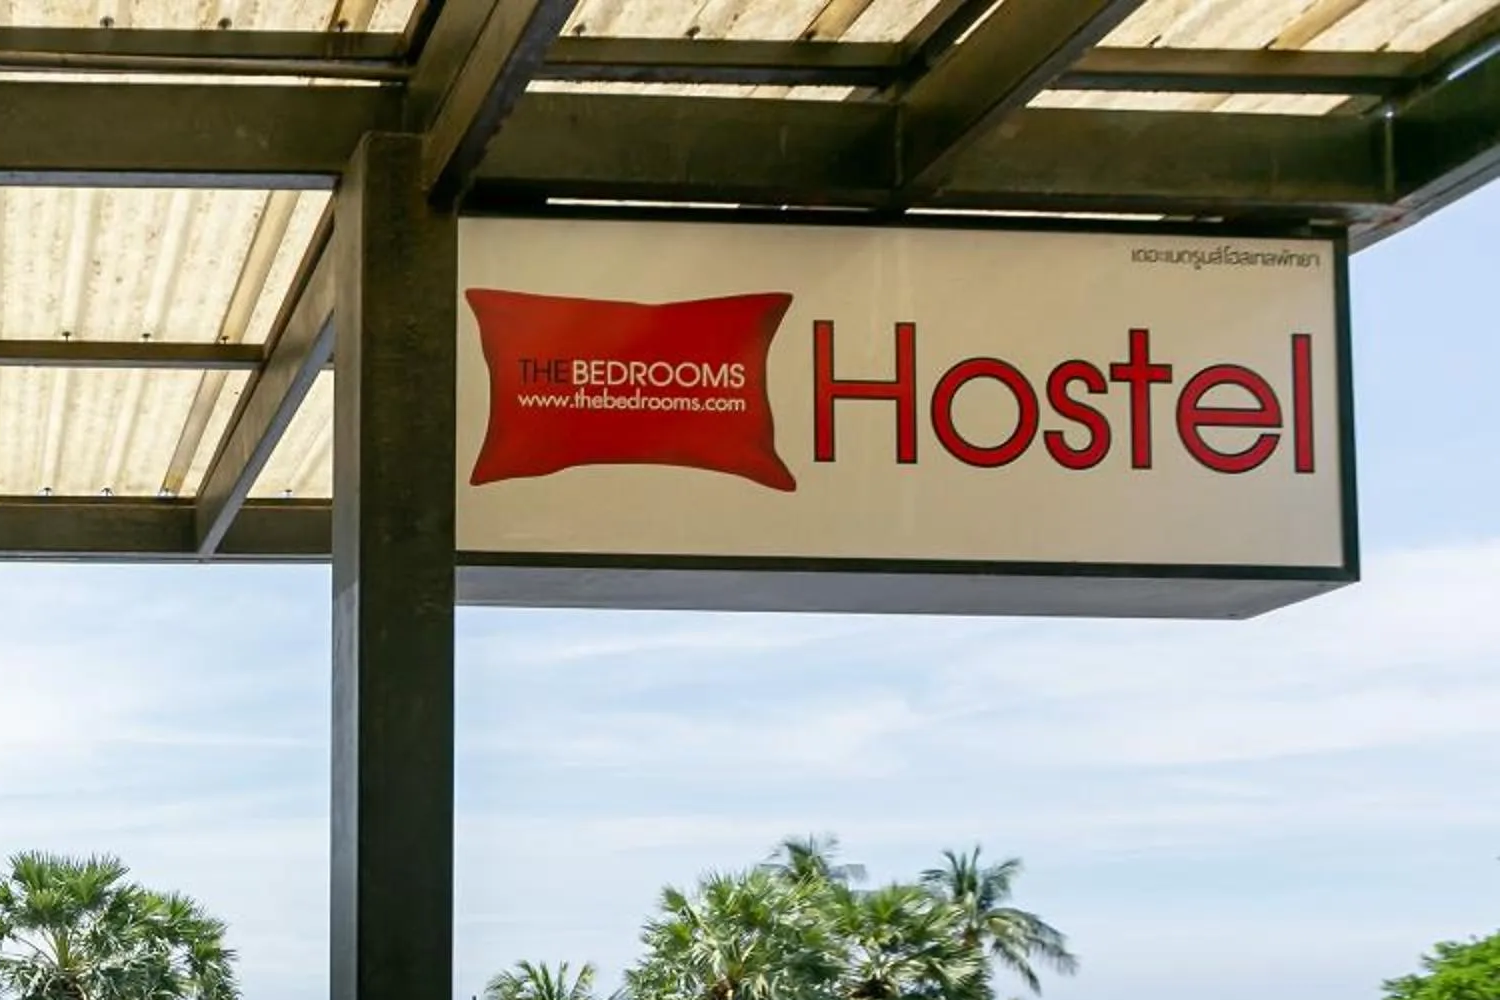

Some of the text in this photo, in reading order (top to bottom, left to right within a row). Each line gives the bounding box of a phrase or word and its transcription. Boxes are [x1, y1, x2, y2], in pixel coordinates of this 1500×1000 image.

[518, 359, 746, 389] THE BEDROOMS
[518, 388, 746, 412] www.thebedrooms.com
[813, 319, 1315, 475] Hostel
